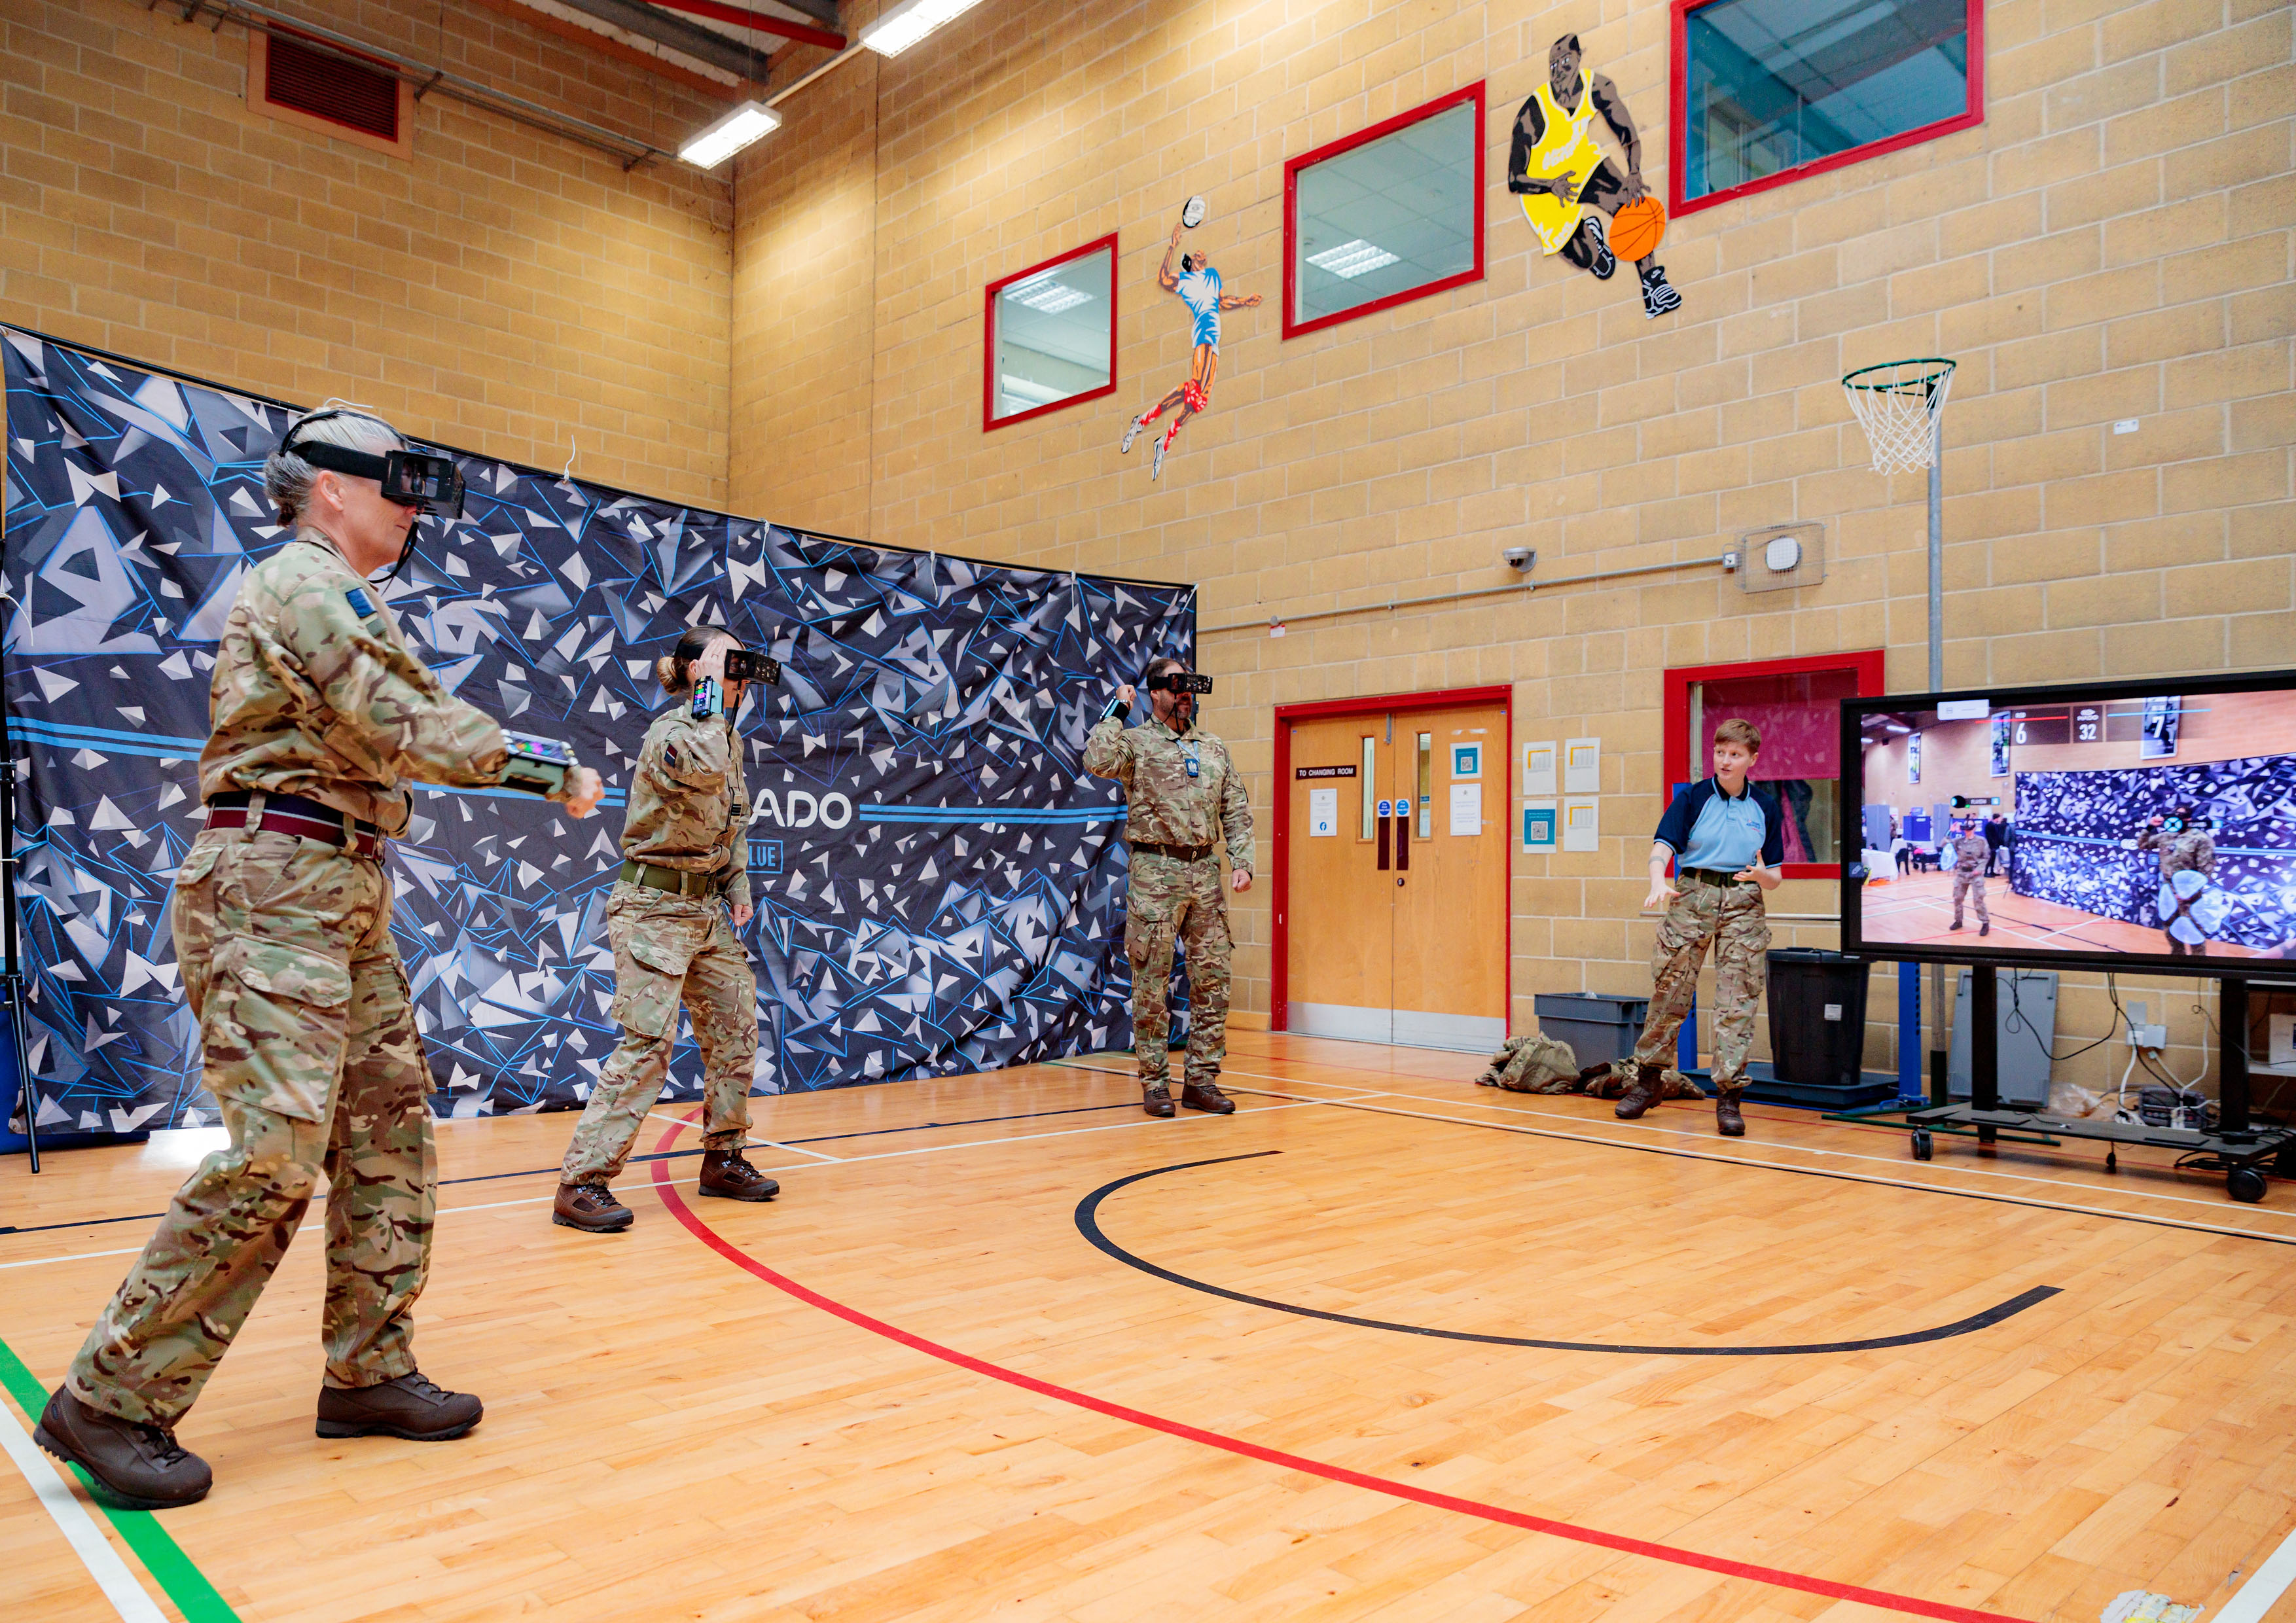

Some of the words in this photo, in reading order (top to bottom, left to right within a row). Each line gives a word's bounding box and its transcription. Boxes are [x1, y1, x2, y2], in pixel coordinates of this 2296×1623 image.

[2015, 722, 2027, 744] 6
[2079, 723, 2096, 740] 32
[2151, 715, 2165, 738] 7
[1308, 768, 1335, 777] CHANGING
[748, 788, 852, 830] ADO
[748, 846, 776, 867] LUE
